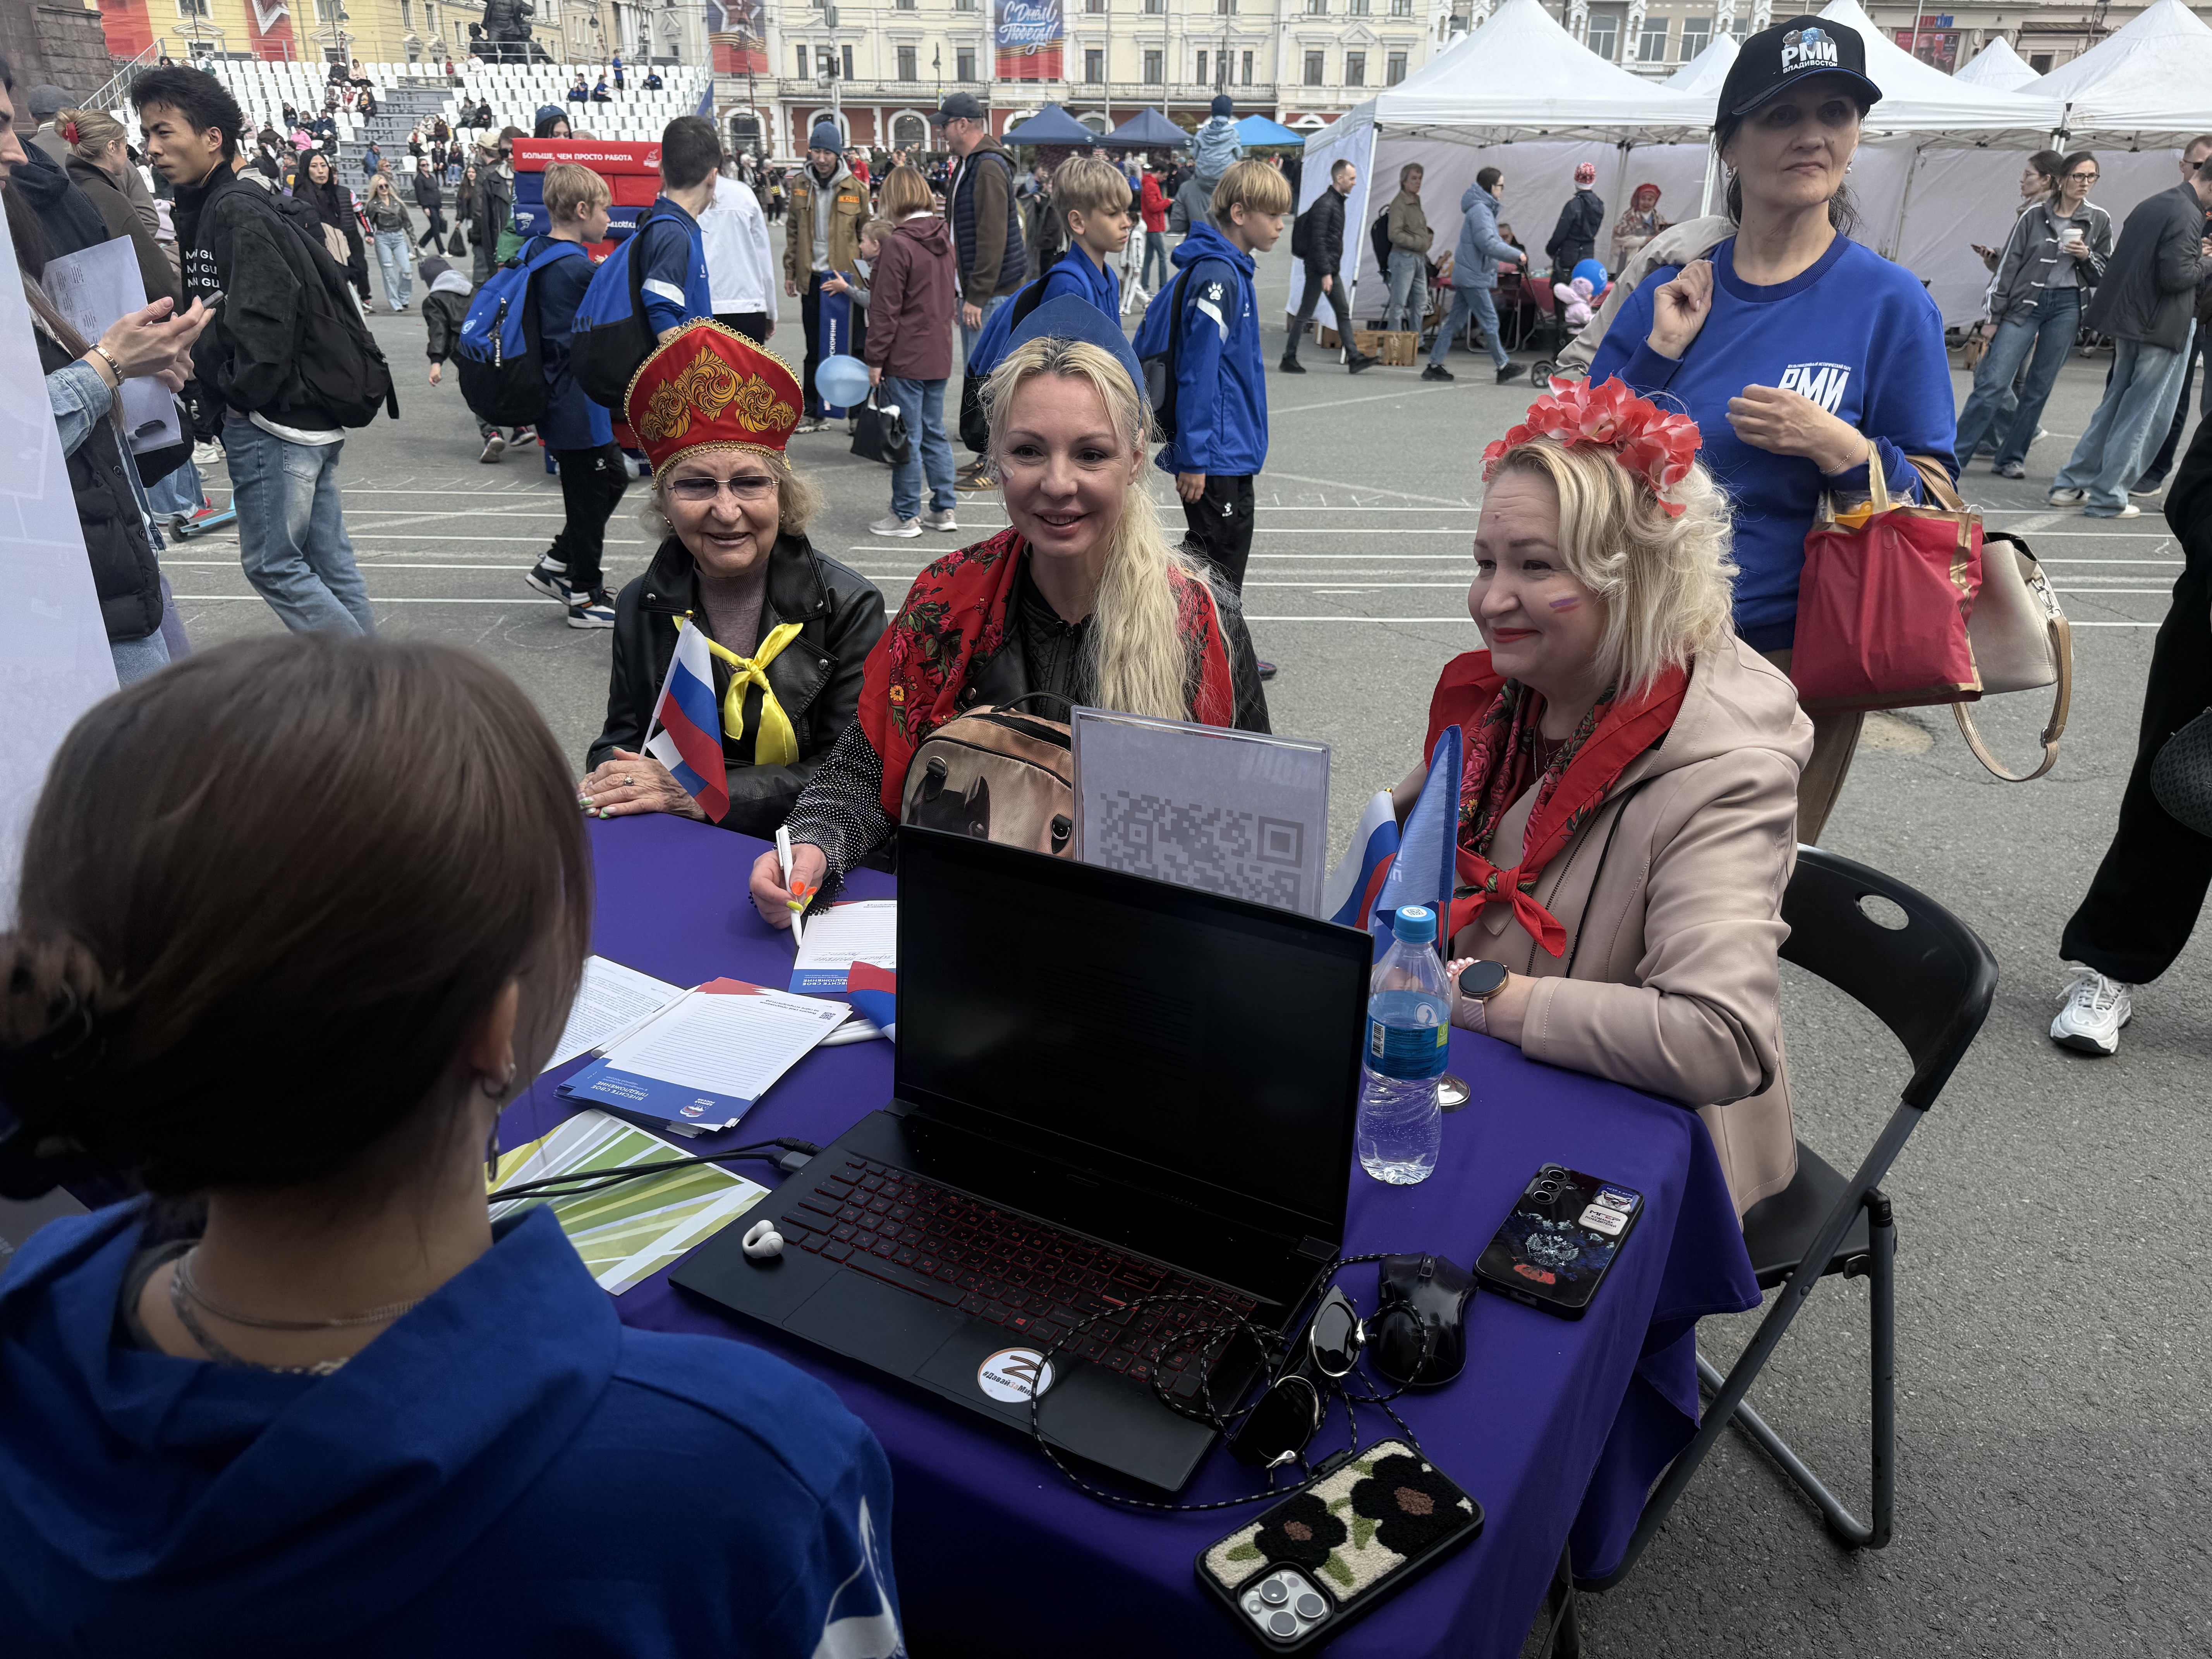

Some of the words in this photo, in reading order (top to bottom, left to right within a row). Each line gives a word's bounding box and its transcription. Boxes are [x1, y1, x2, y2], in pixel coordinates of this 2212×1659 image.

[1781, 41, 1838, 68] РМИ
[596, 1081, 649, 1097] ПРЕДЛОЖЕНИЕ
[610, 1089, 644, 1101] ВНЕСИТЕ
[1585, 1216, 1616, 1228] ПОБЕДИТЕЛЕЙ
[1591, 1215, 1613, 1224] КОМАНДА
